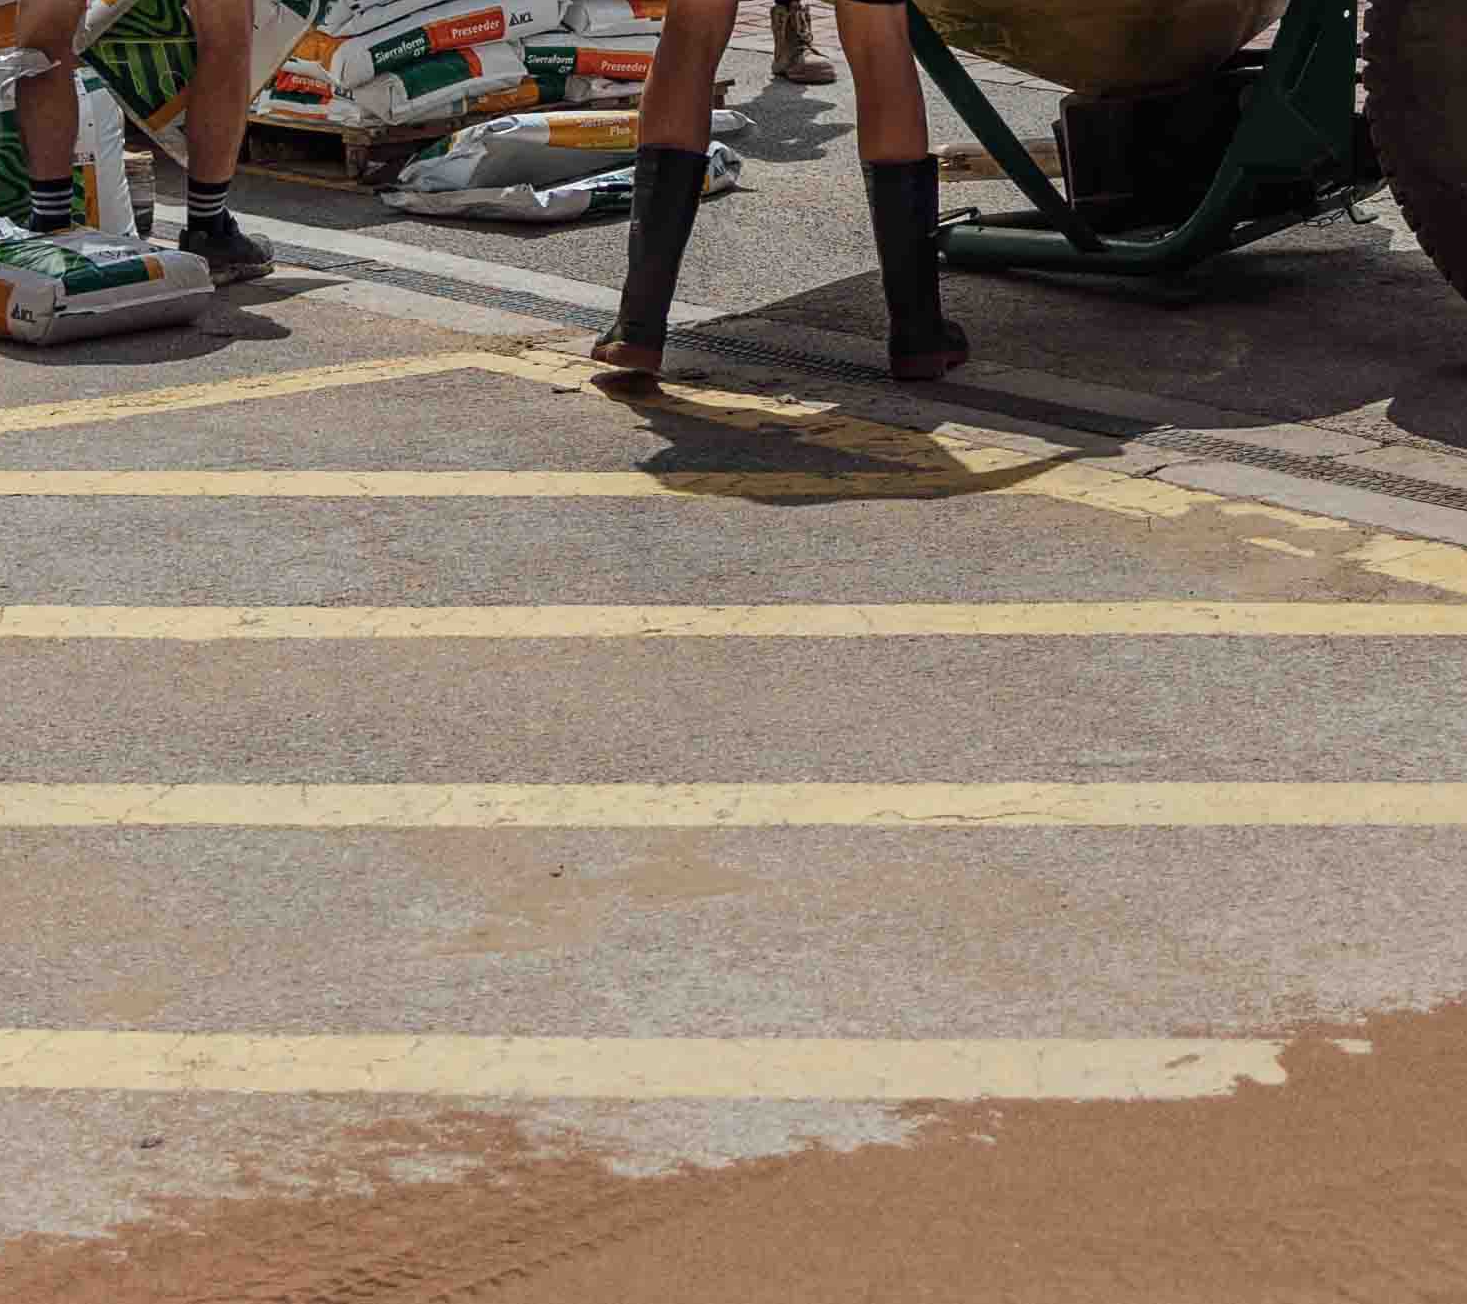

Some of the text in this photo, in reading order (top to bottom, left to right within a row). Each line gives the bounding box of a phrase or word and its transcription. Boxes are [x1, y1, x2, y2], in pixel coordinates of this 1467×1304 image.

[451, 18, 501, 40] Preseeder
[375, 36, 426, 65] Sierraform
[527, 53, 575, 66] Sierraform
[600, 59, 648, 73] Preseeder
